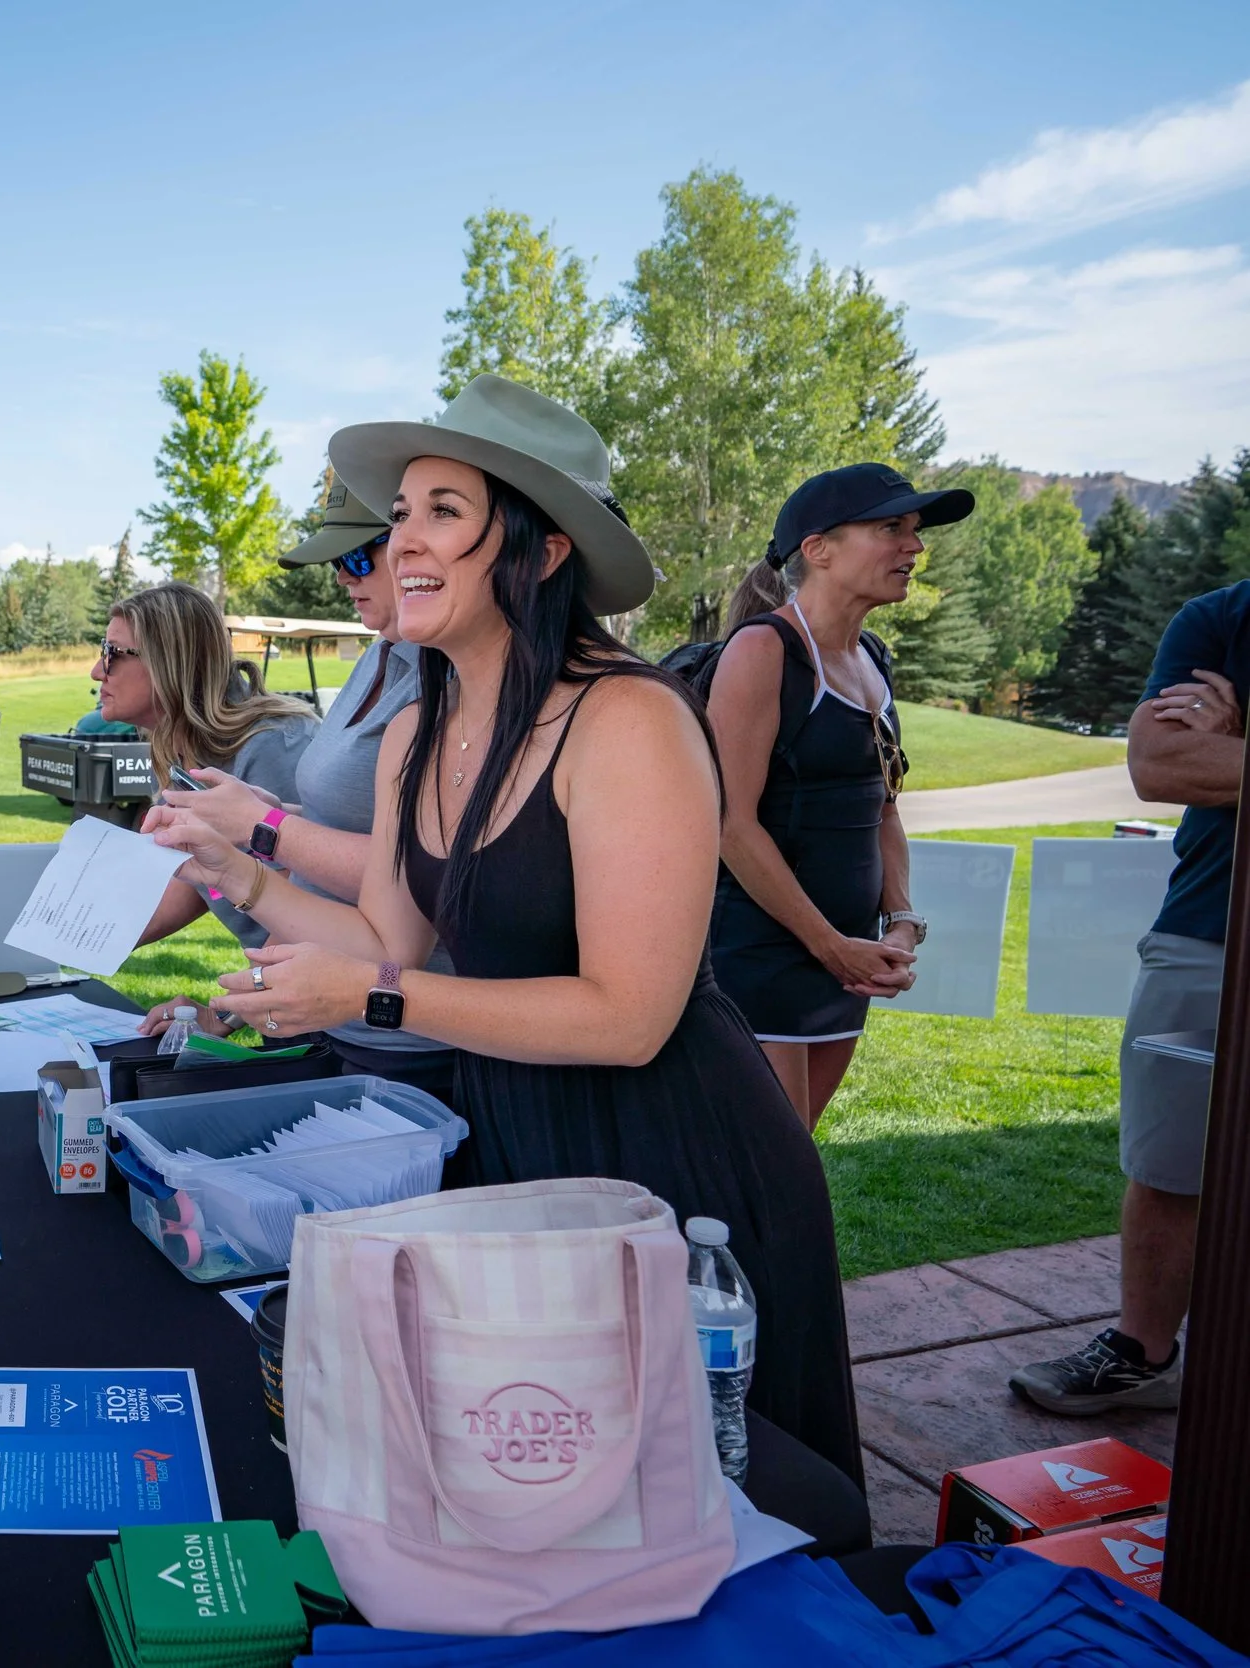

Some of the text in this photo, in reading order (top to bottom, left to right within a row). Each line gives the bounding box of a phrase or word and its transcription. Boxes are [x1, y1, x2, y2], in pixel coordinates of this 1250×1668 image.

[27, 757, 74, 776] PEAK PROJECTS
[116, 758, 152, 770] PEAK
[64, 1138, 94, 1146] GUMMED
[64, 1146, 100, 1154] ENVELOPES
[50, 1384, 61, 1428] PARAGON
[106, 1386, 128, 1423] GOLF
[126, 1388, 139, 1421] PARTNER
[138, 1388, 150, 1422] PARAGON
[461, 1410, 596, 1436] TRADER
[481, 1437, 578, 1464] JOE'S
[156, 1461, 168, 1482] ASPEN
[184, 1533, 217, 1618] PARAGON
